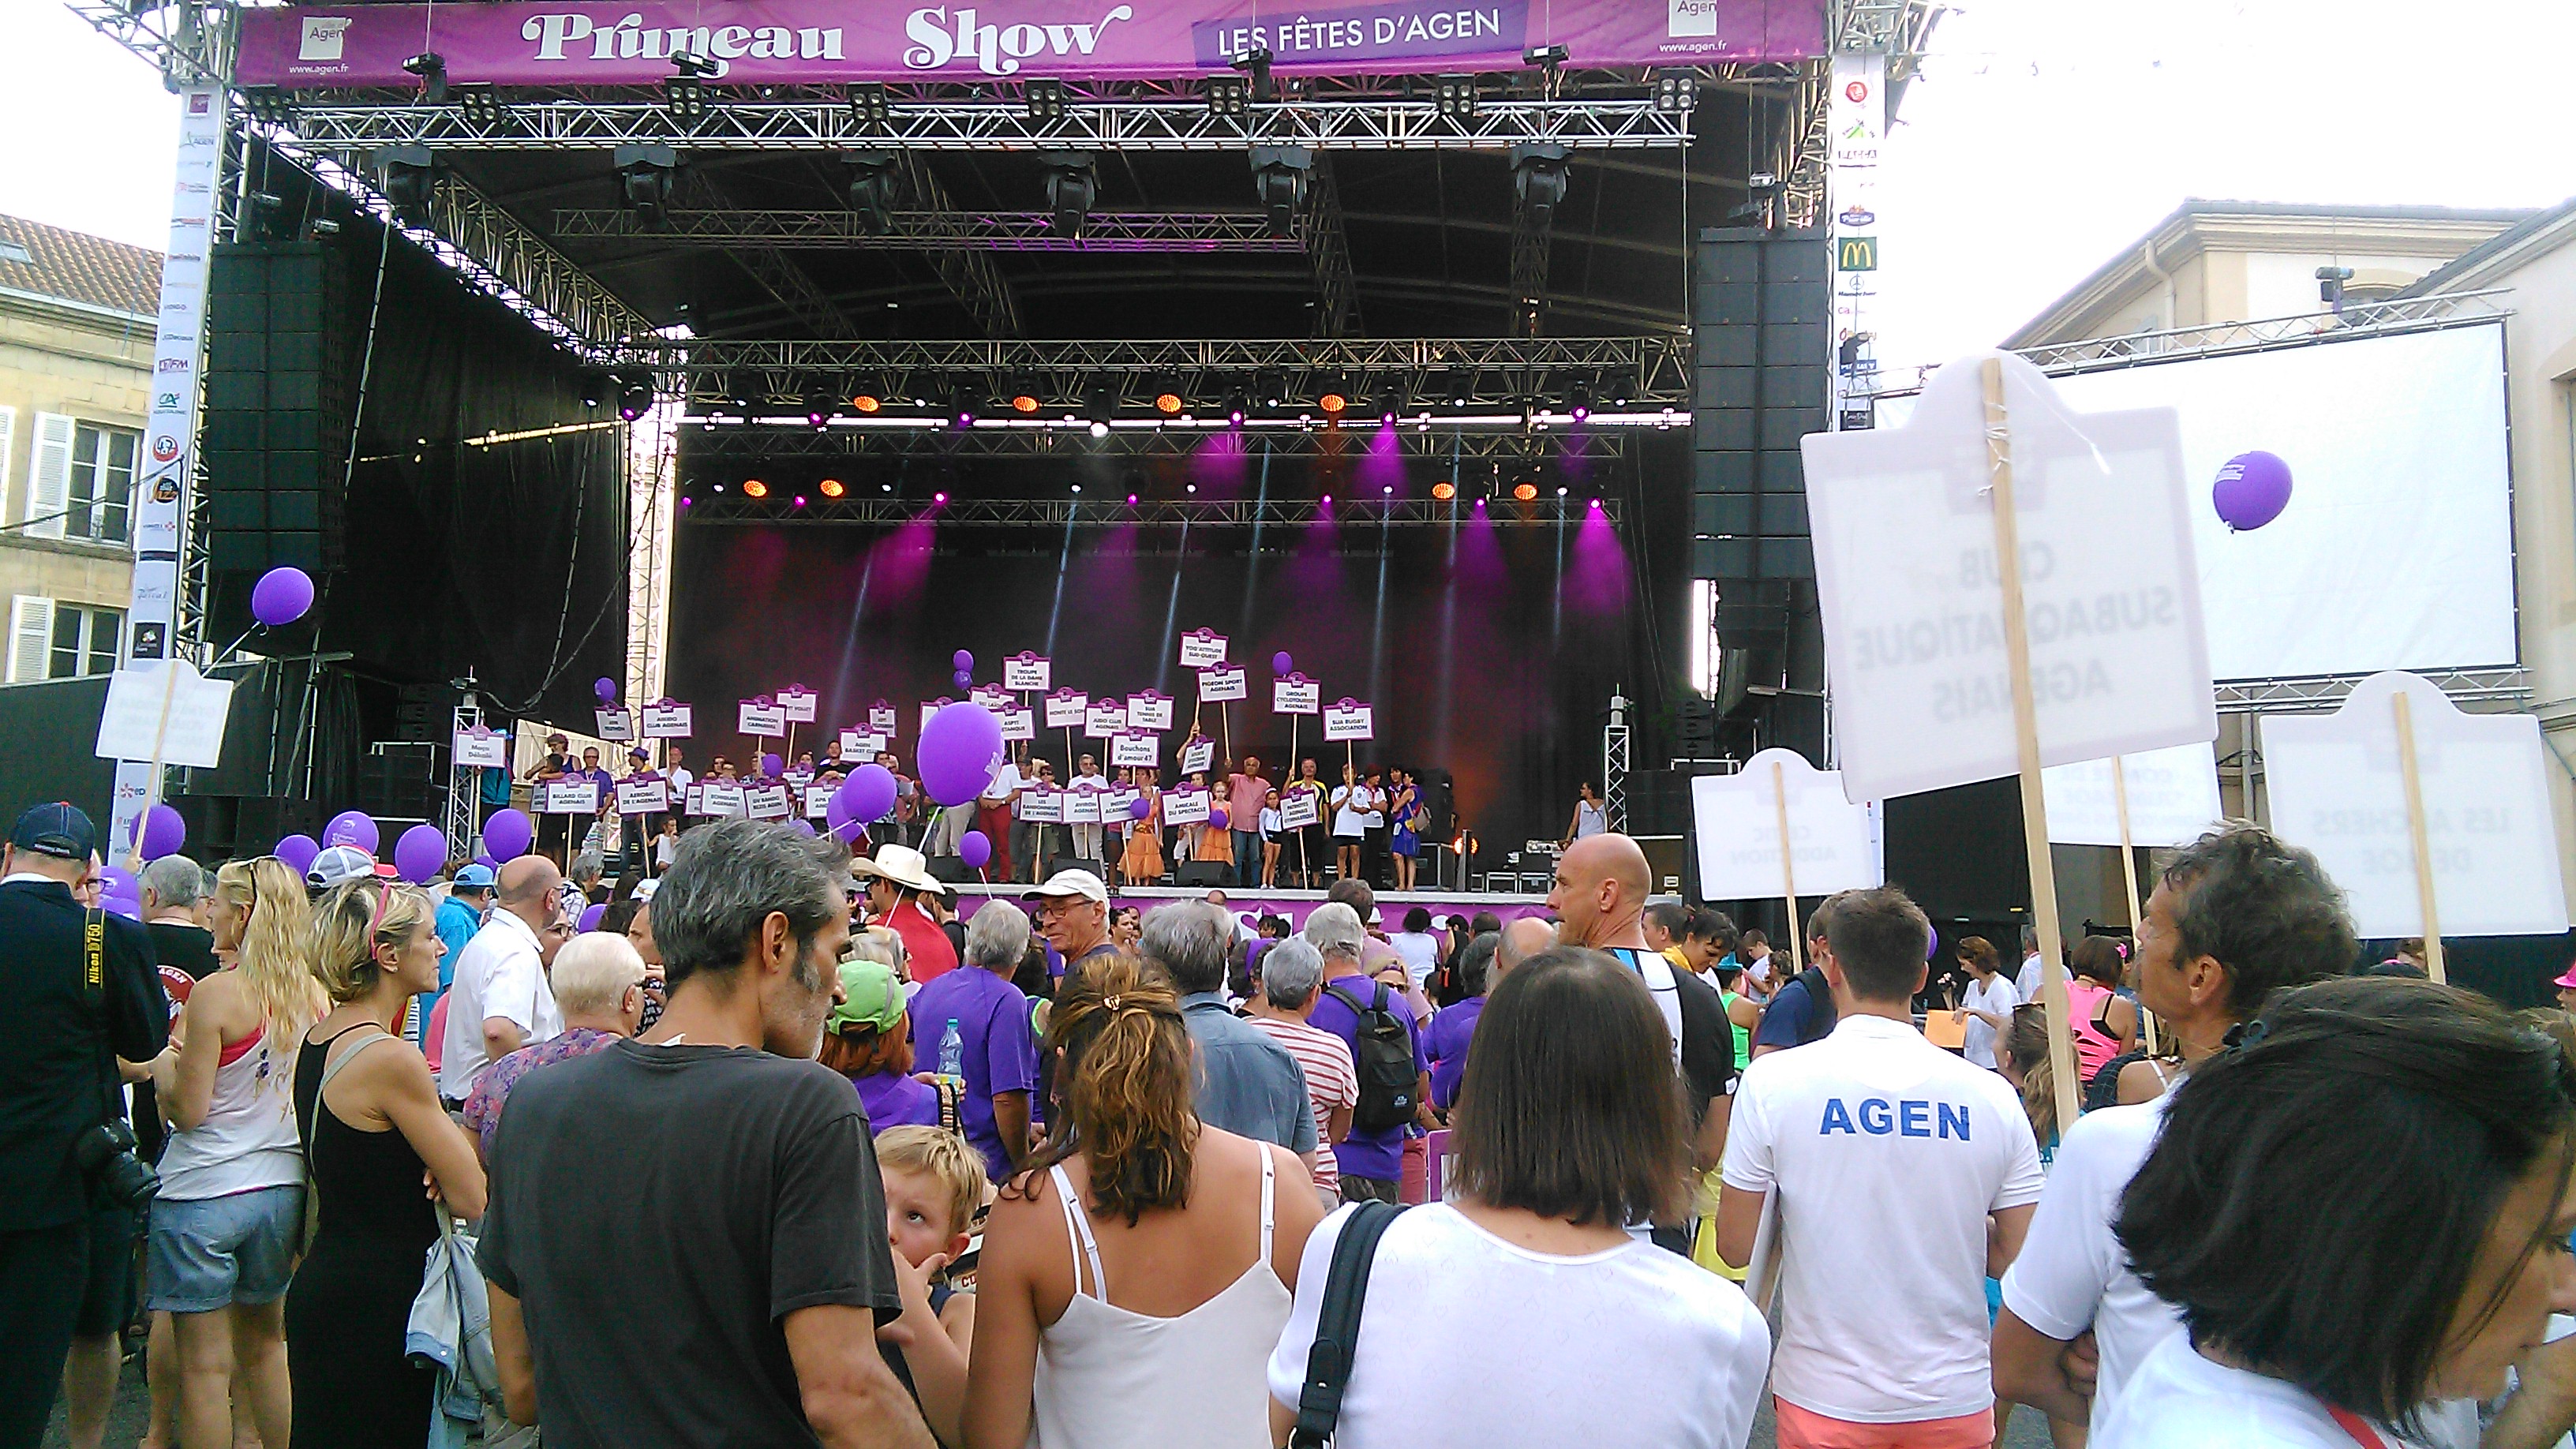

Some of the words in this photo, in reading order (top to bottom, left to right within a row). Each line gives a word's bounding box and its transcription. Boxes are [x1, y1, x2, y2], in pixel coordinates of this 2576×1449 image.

[1677, 0, 1717, 16] Agen
[309, 27, 344, 41] Agen
[522, 13, 846, 79] Pruneau
[903, 5, 1133, 76] Show
[1219, 28, 1269, 57] LES
[1278, 16, 1365, 52] FÊTES
[1374, 9, 1500, 45] D'AGEN
[1659, 39, 1727, 53] www.agen.fr
[86, 924, 102, 952] D750
[88, 953, 100, 984] Nikon
[1818, 1098, 1972, 1142] AGEN
